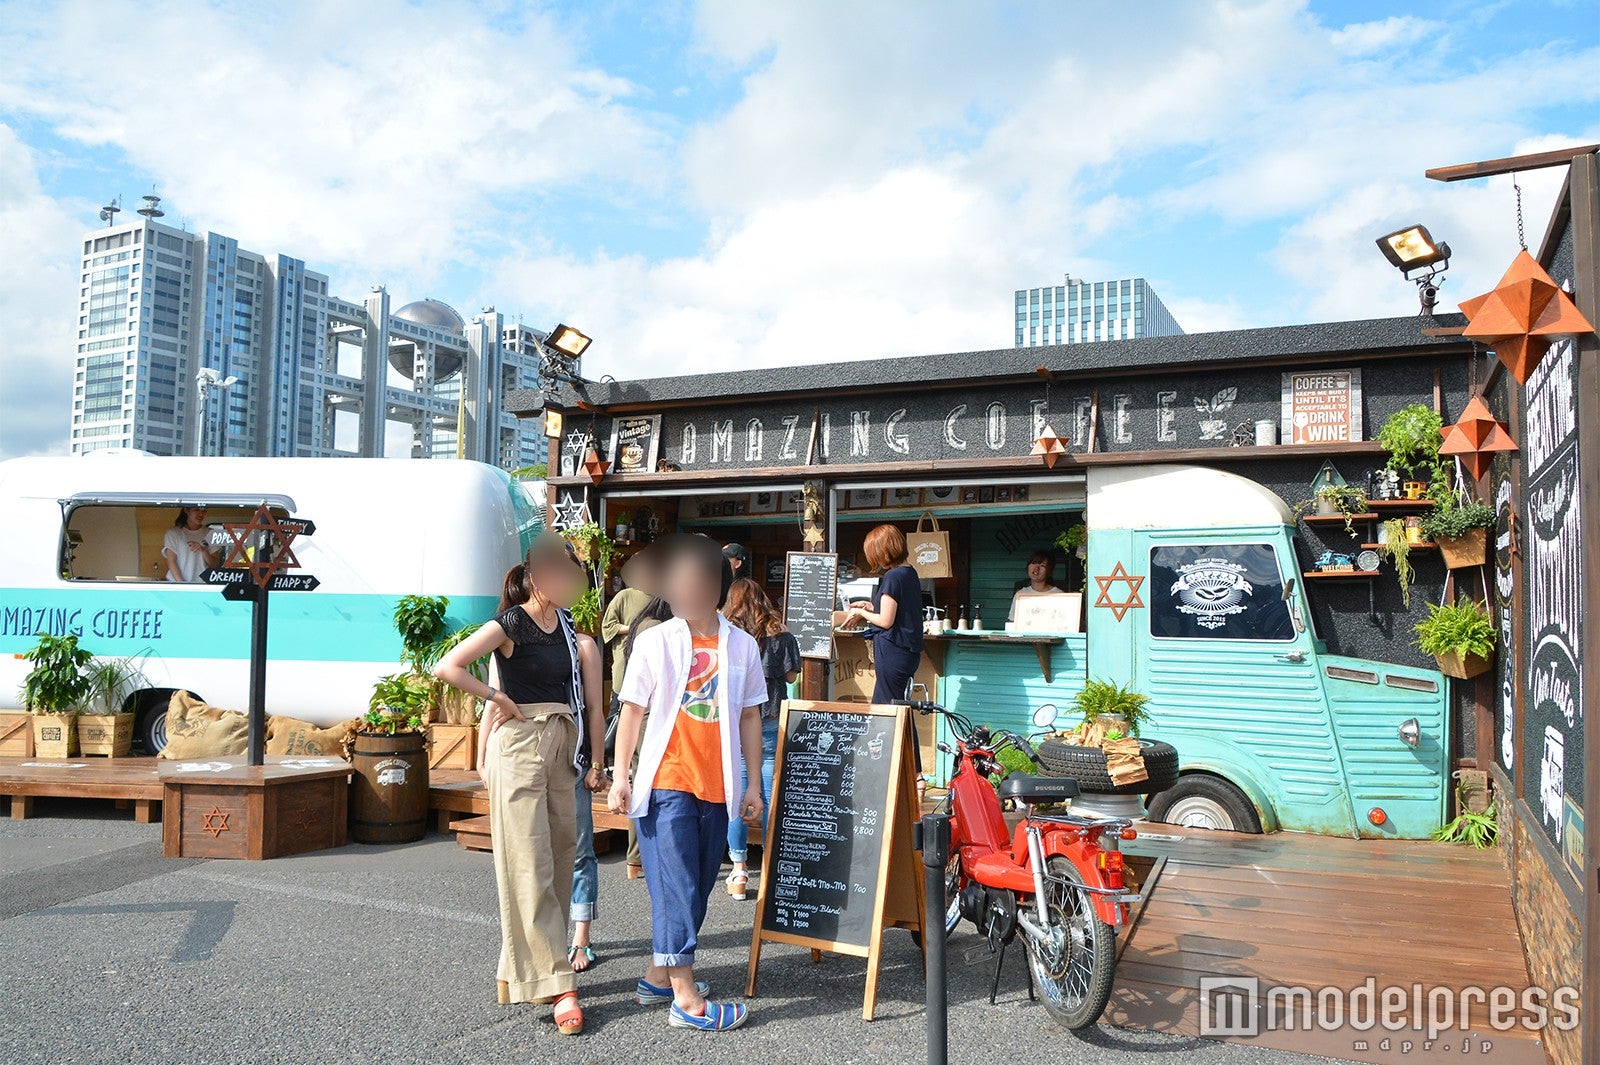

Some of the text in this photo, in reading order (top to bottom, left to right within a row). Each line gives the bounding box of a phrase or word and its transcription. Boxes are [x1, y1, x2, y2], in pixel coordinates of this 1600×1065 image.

[1296, 377, 1334, 390] COFFEE
[1296, 395, 1346, 404] UNTIL IT'S
[1309, 411, 1345, 423] DRINK
[619, 424, 651, 439] Vintage
[679, 390, 1178, 465] AMAZING COFFEE
[1308, 425, 1348, 441] WINE
[1321, 564, 1354, 572] WELCOME
[209, 570, 244, 582] DREAM
[0, 607, 163, 639] MAZING COFFEE
[803, 712, 862, 722] DRINK MENU
[863, 808, 877, 817] 500
[862, 817, 876, 825] 500
[853, 825, 874, 835] 4,800
[854, 883, 866, 894] 700
